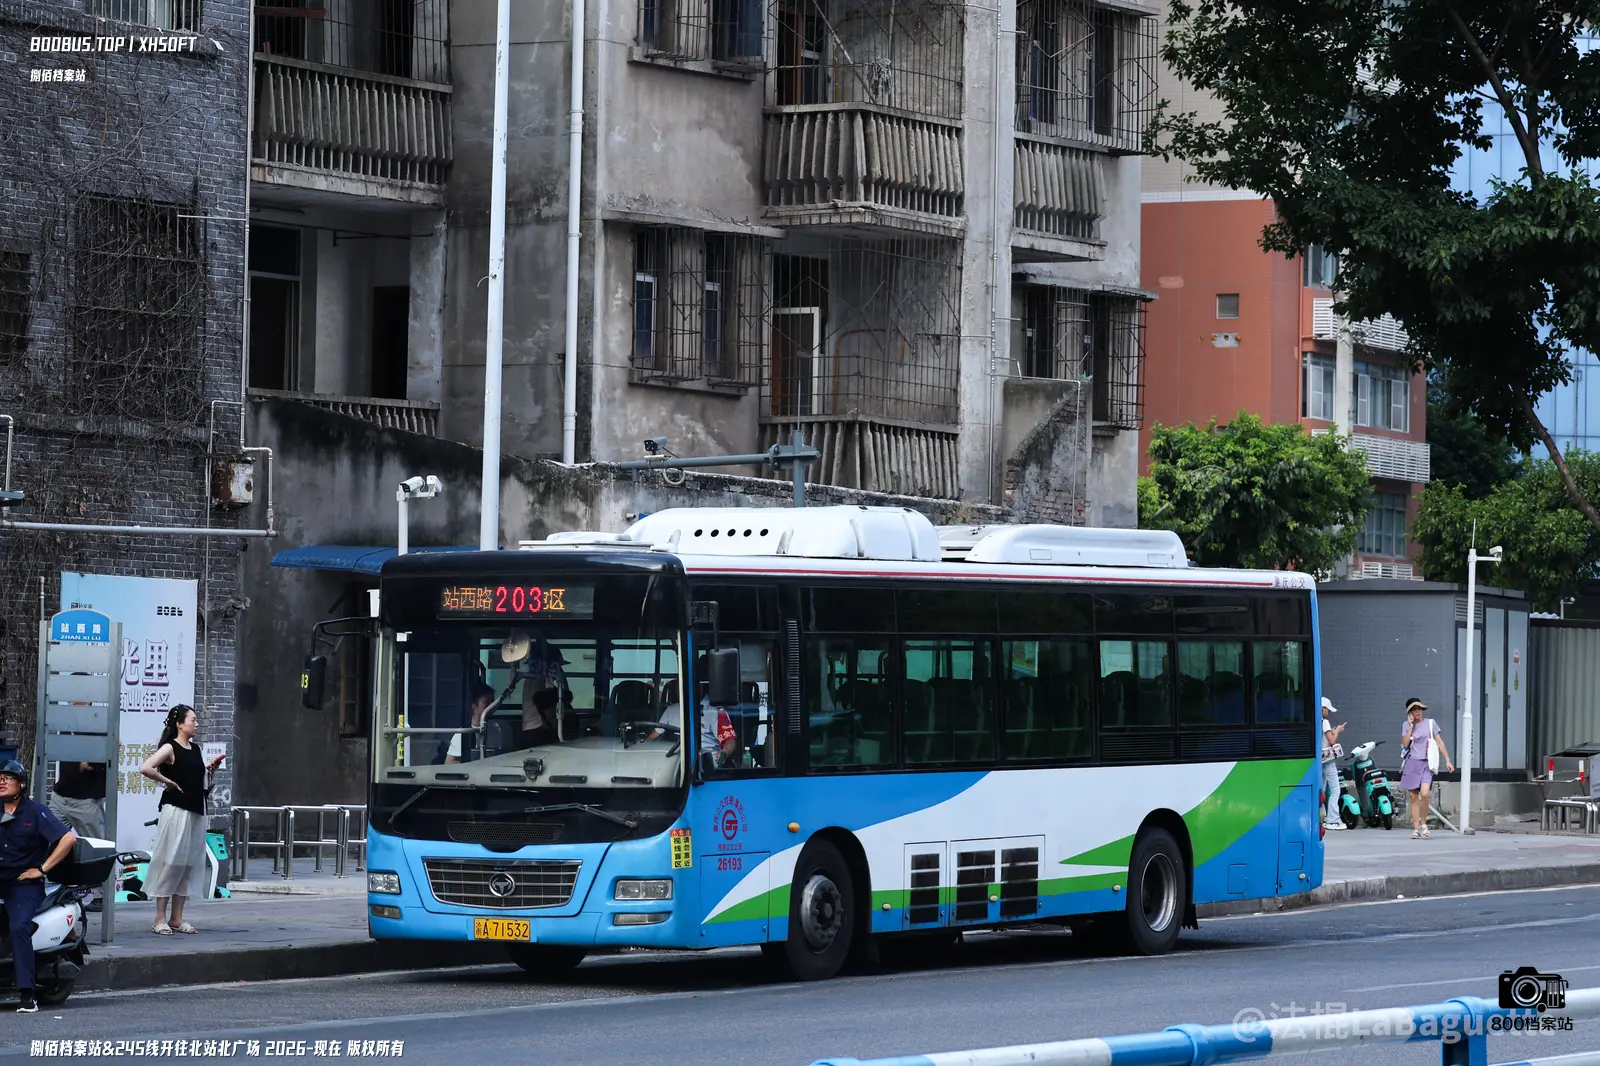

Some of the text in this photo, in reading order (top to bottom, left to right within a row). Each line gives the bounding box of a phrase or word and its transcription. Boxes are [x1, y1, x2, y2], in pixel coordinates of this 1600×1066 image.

[443, 586, 493, 610] 站西路
[495, 586, 542, 613] 203
[156, 606, 184, 617] 2026
[60, 622, 102, 634] 站西路
[717, 857, 742, 871] 26193
